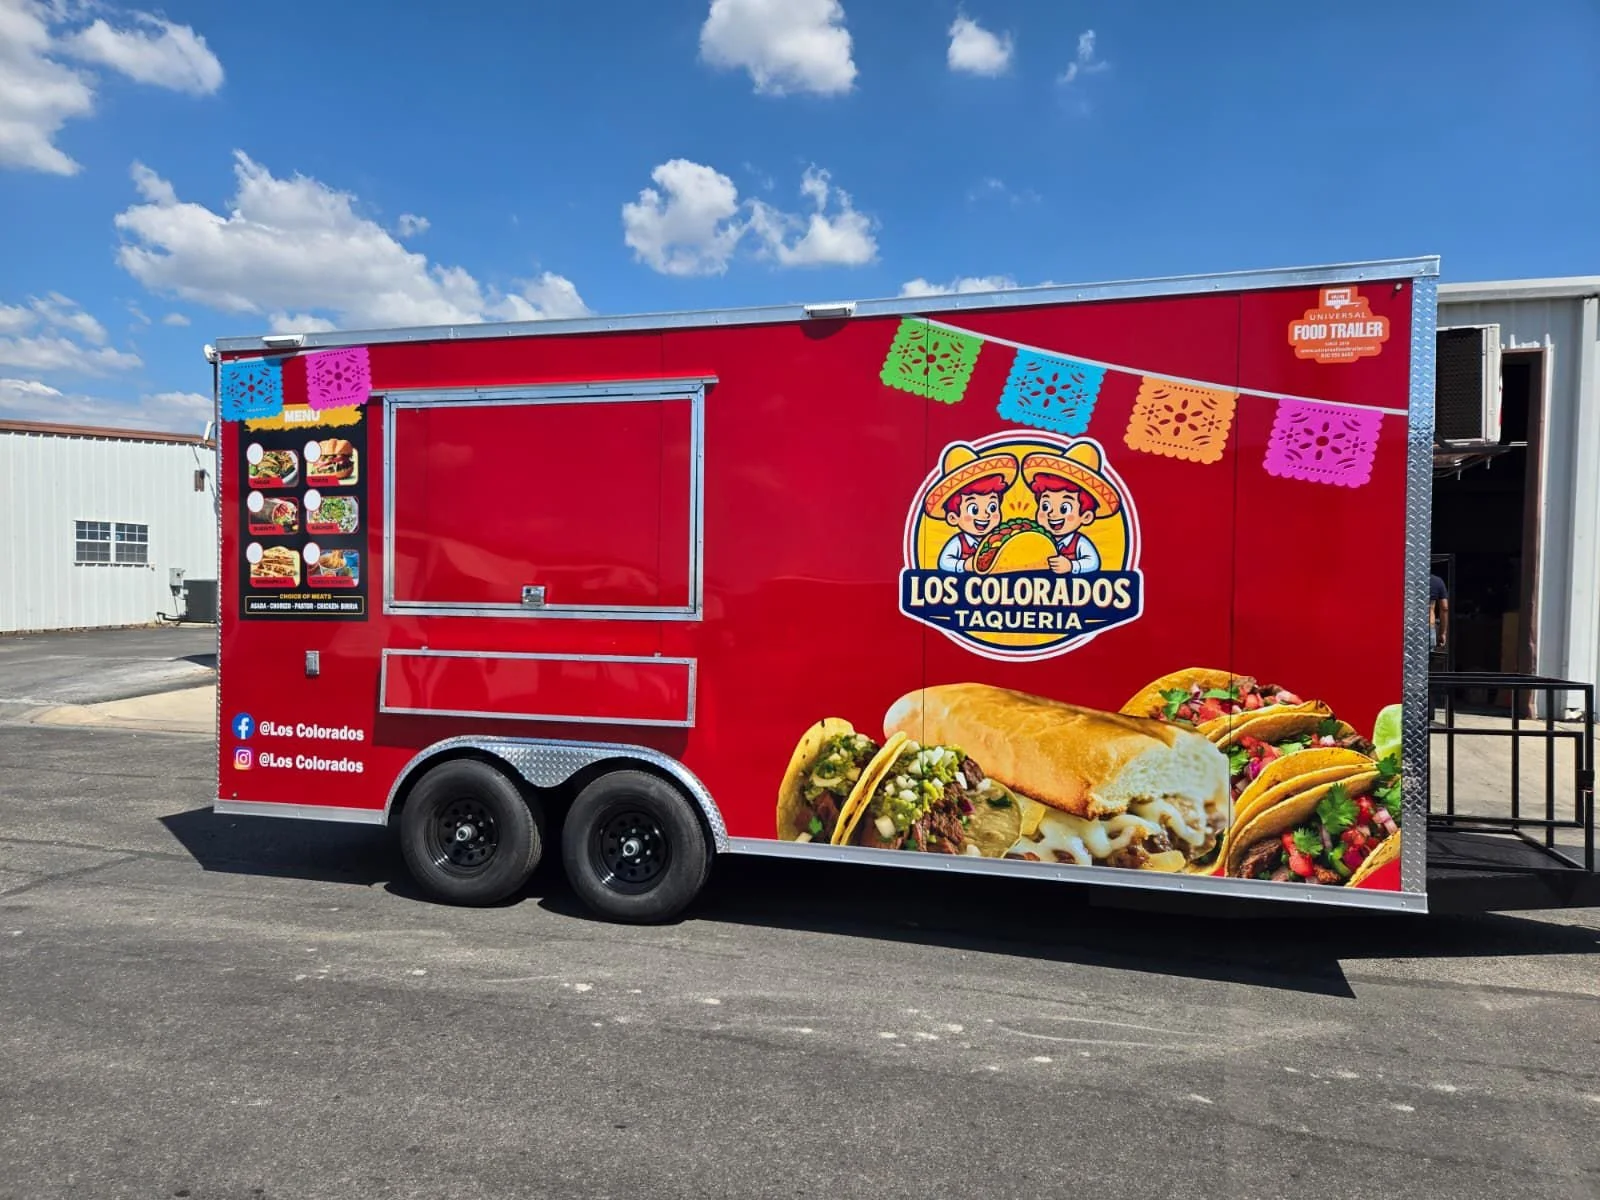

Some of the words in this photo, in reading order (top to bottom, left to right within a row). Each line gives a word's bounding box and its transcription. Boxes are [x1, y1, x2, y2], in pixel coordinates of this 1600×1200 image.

[1309, 312, 1367, 320] UNIVERSAL
[1293, 323, 1327, 341] FOOD
[1329, 321, 1384, 339] TRAILER
[284, 410, 320, 423] MENU
[910, 576, 959, 607] LOS
[965, 577, 1132, 609] COLORADOS
[954, 610, 1082, 631] TAQUERIA
[259, 721, 293, 737] @Los
[296, 723, 365, 741] Colorados
[259, 752, 293, 769] @Los
[295, 754, 364, 773] Colorados
